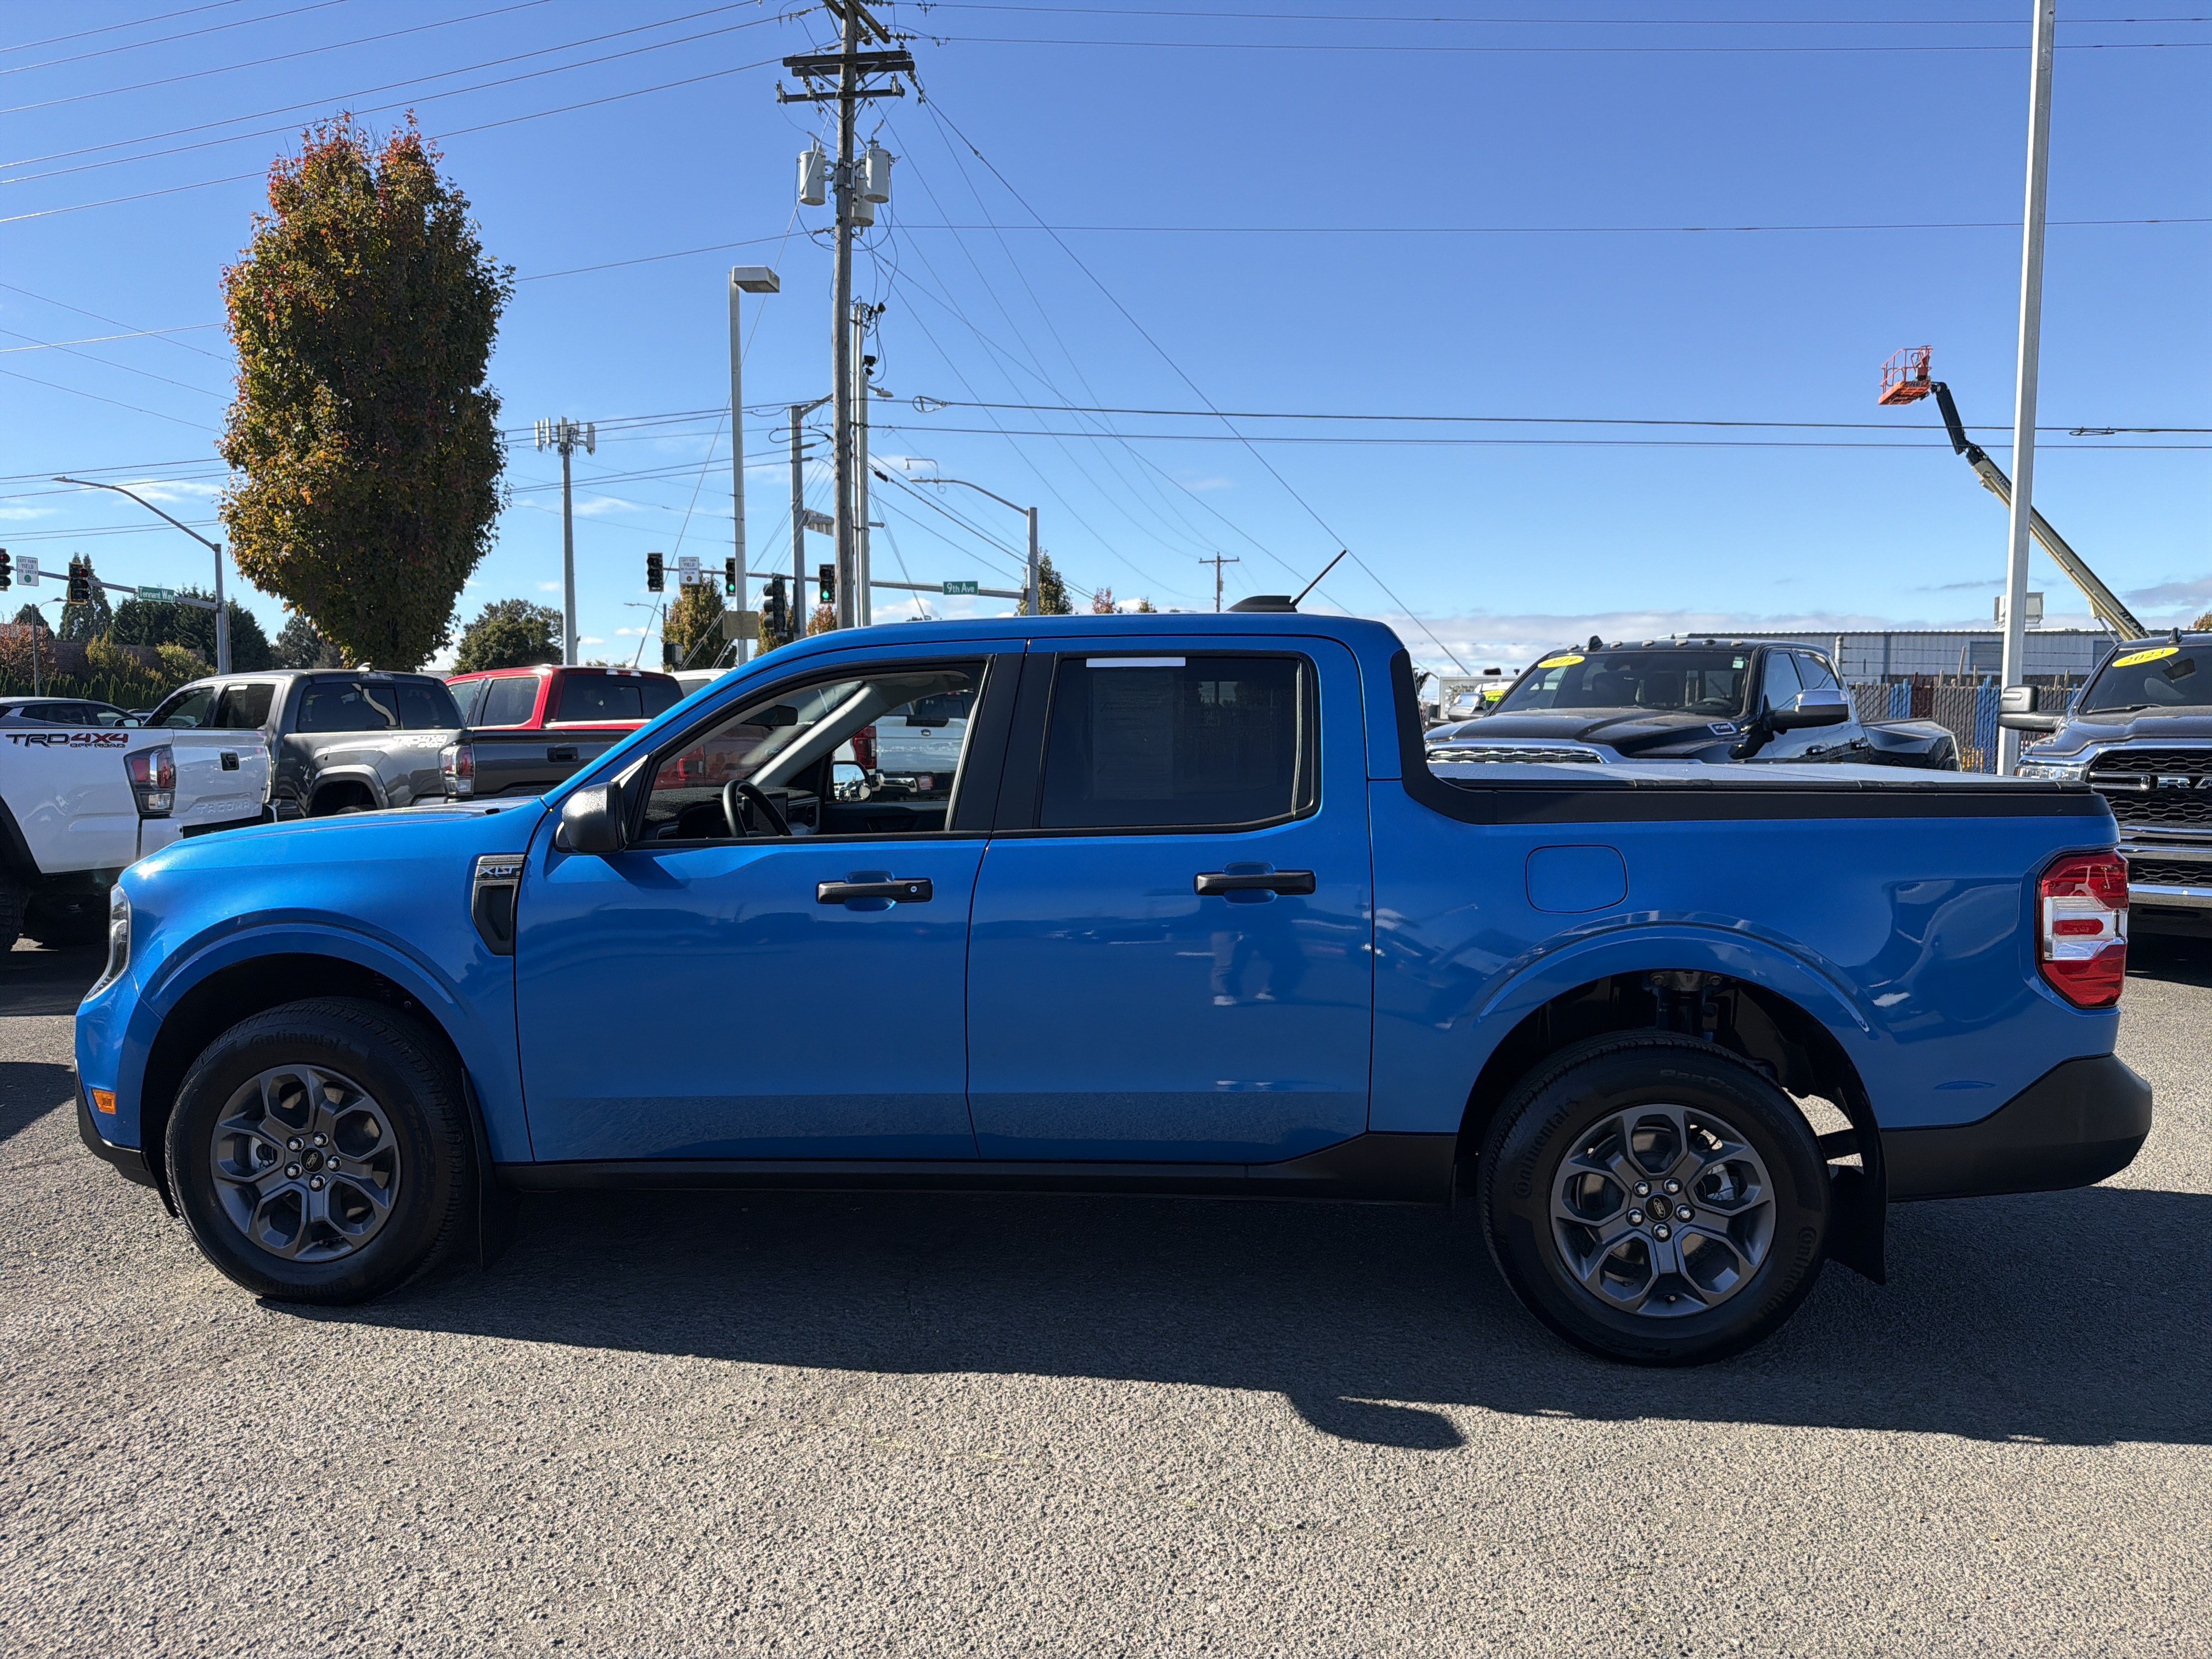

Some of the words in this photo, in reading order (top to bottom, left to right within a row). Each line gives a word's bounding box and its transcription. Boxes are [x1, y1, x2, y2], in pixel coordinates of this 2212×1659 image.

[946, 583, 960, 593] 9th
[961, 582, 975, 593] Ave
[138, 587, 161, 599] Tennant
[161, 589, 175, 603] Way
[476, 866, 522, 877] XLT
